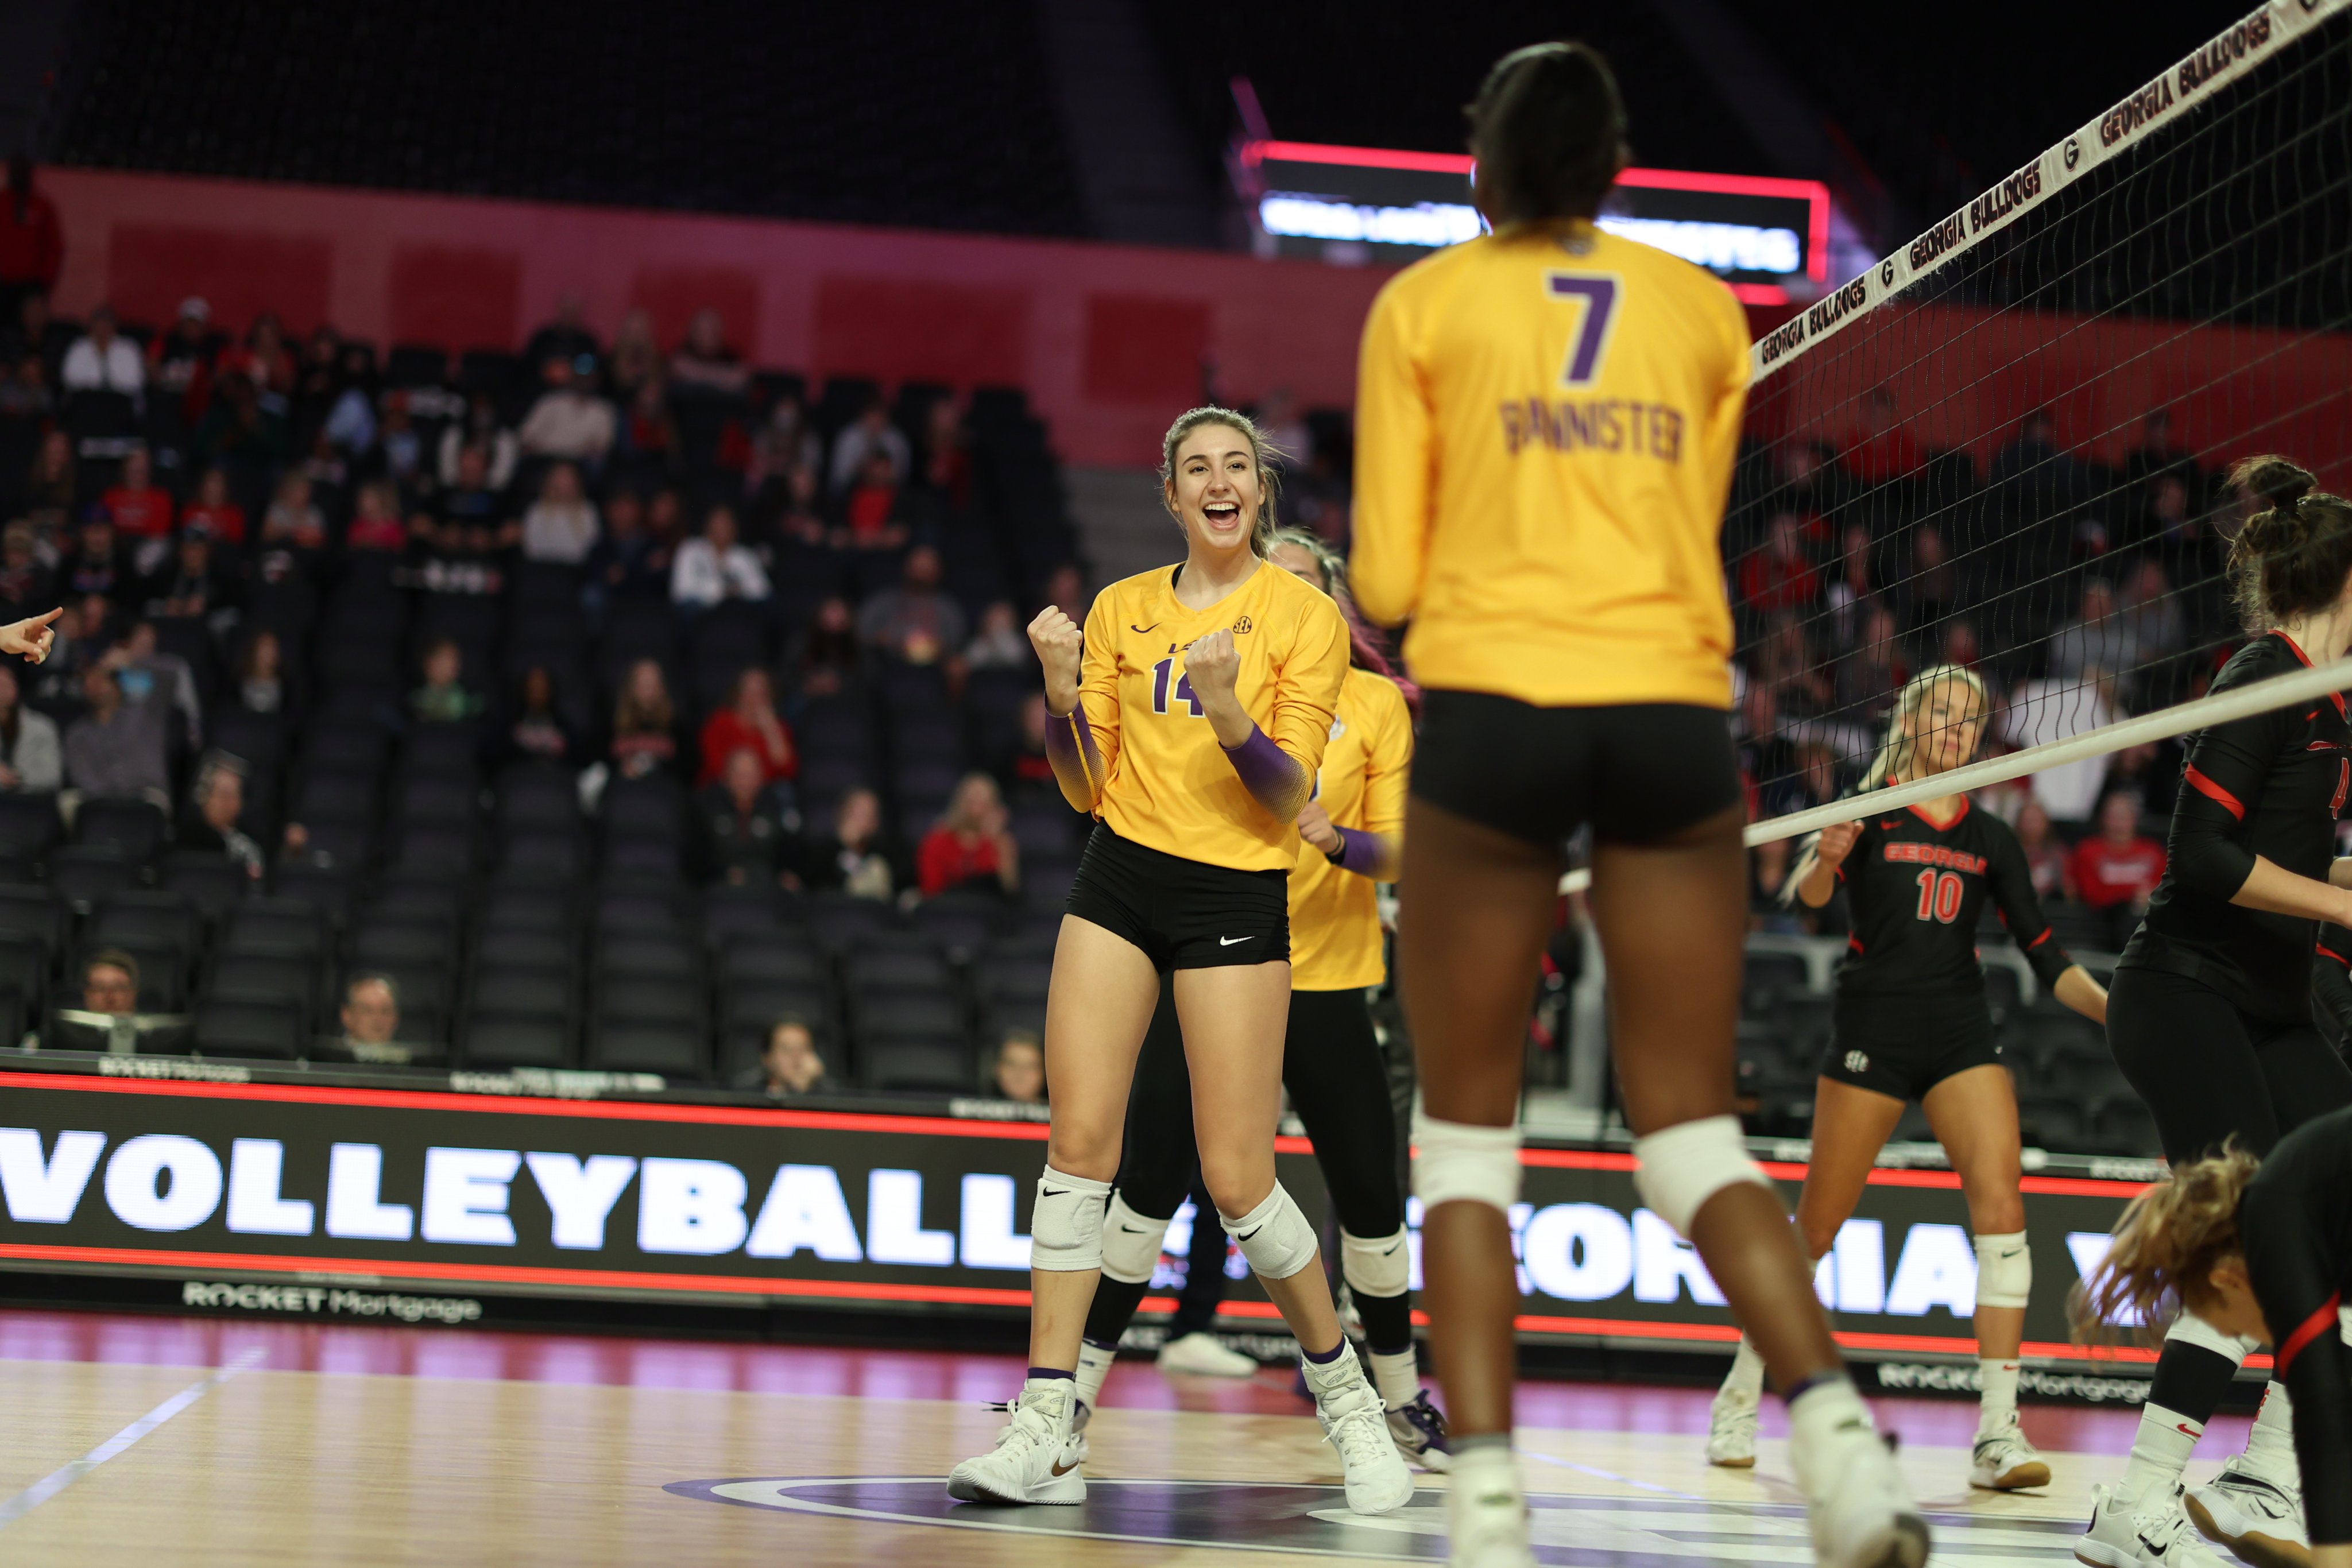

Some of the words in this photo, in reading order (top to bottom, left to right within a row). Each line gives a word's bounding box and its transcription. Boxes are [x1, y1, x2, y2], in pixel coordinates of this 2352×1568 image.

[1762, 316, 1805, 365] GEORGIA
[1809, 275, 1866, 336] BULLDOGS
[1881, 259, 1894, 289] G
[1910, 210, 1967, 271] GEORGIA
[1970, 158, 2041, 234] BULLDOGS
[2064, 137, 2080, 172] G
[2100, 75, 2174, 148] GEORGIA
[1544, 270, 1623, 389] 7
[1233, 615, 1252, 634] SEC
[1916, 866, 1964, 924] 10
[0, 1127, 1032, 1269] VOLLEYBALL
[182, 1281, 327, 1313] ROCKET
[328, 1288, 482, 1324] Mortgage
[1877, 1362, 1983, 1392] ROCK
